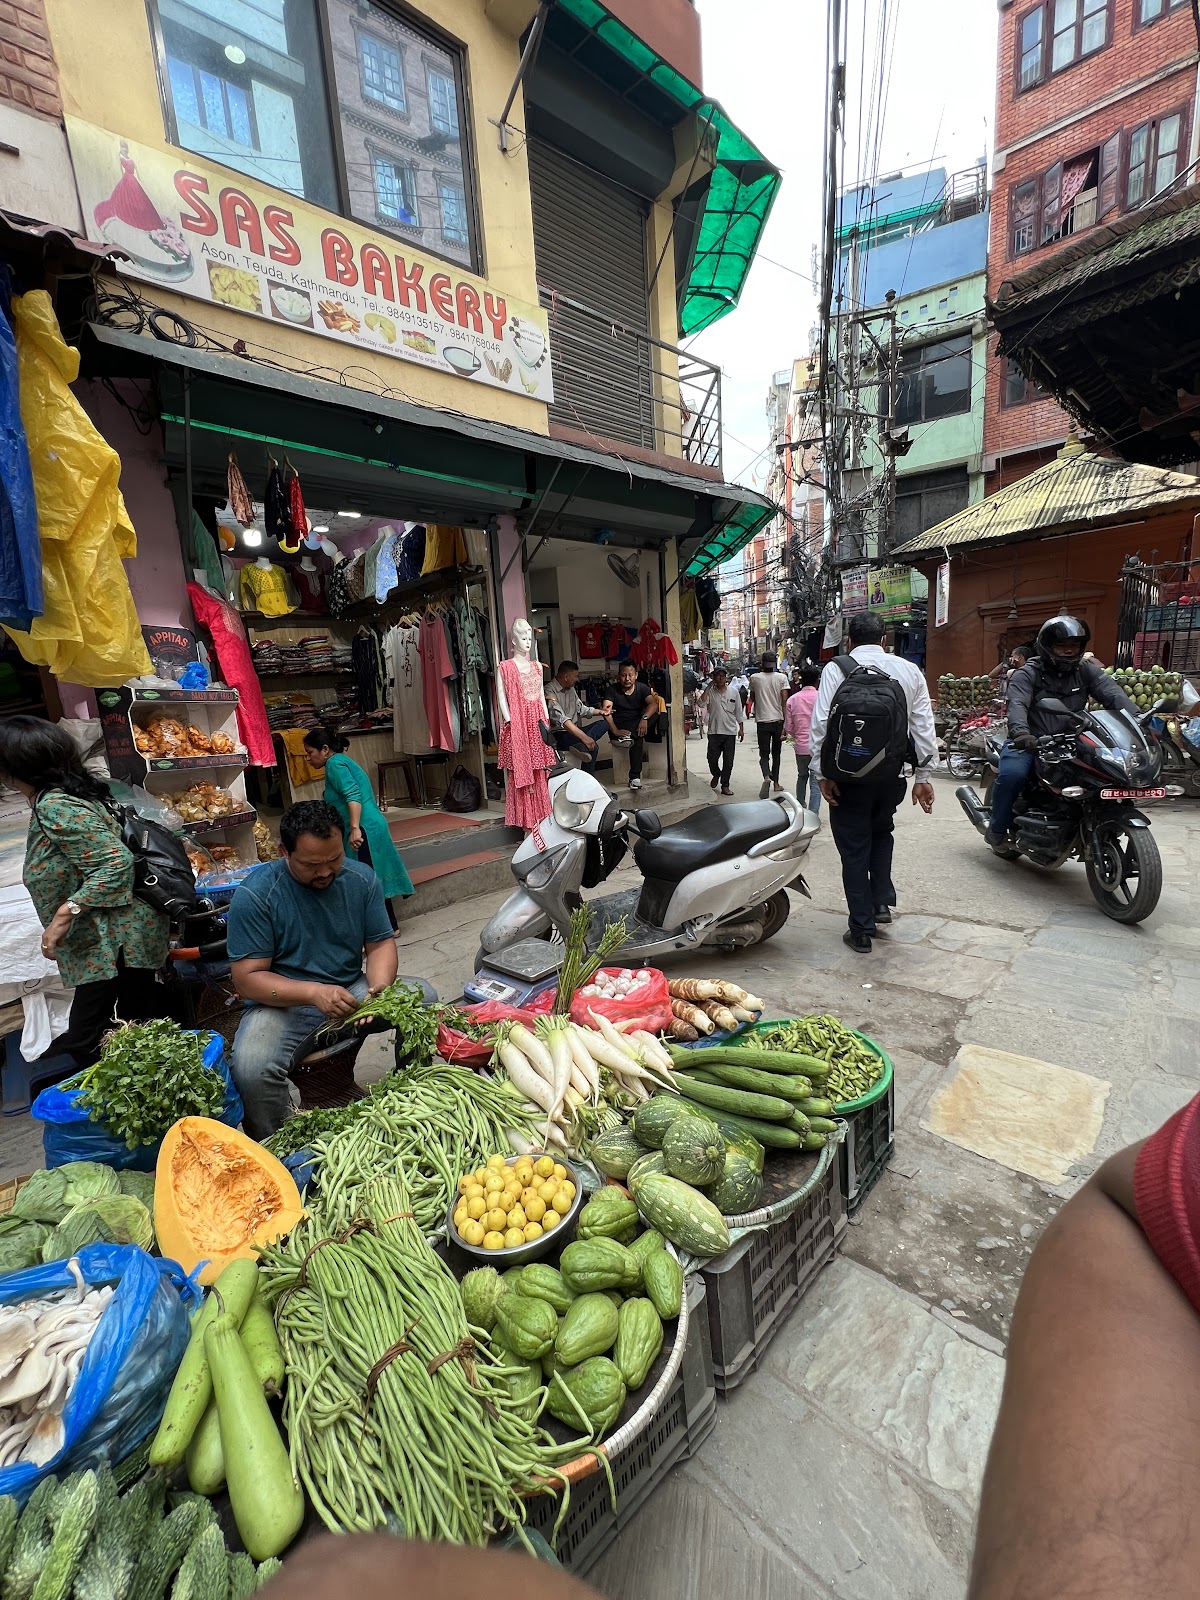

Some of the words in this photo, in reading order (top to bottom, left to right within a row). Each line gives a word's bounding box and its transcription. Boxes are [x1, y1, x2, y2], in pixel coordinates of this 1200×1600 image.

[173, 169, 301, 266] SAS
[320, 228, 507, 341] BAKERY
[201, 242, 239, 267] Ason,
[243, 255, 287, 282] Teuda,
[291, 272, 359, 307] Kathmandu,
[387, 306, 448, 337] 9849135157,
[450, 329, 501, 353] 9841768046
[355, 335, 377, 348] Birthday
[379, 343, 394, 352] cakes
[404, 350, 418, 359] made
[878, 566, 909, 578] ZENITH
[150, 631, 189, 648] APPITAS
